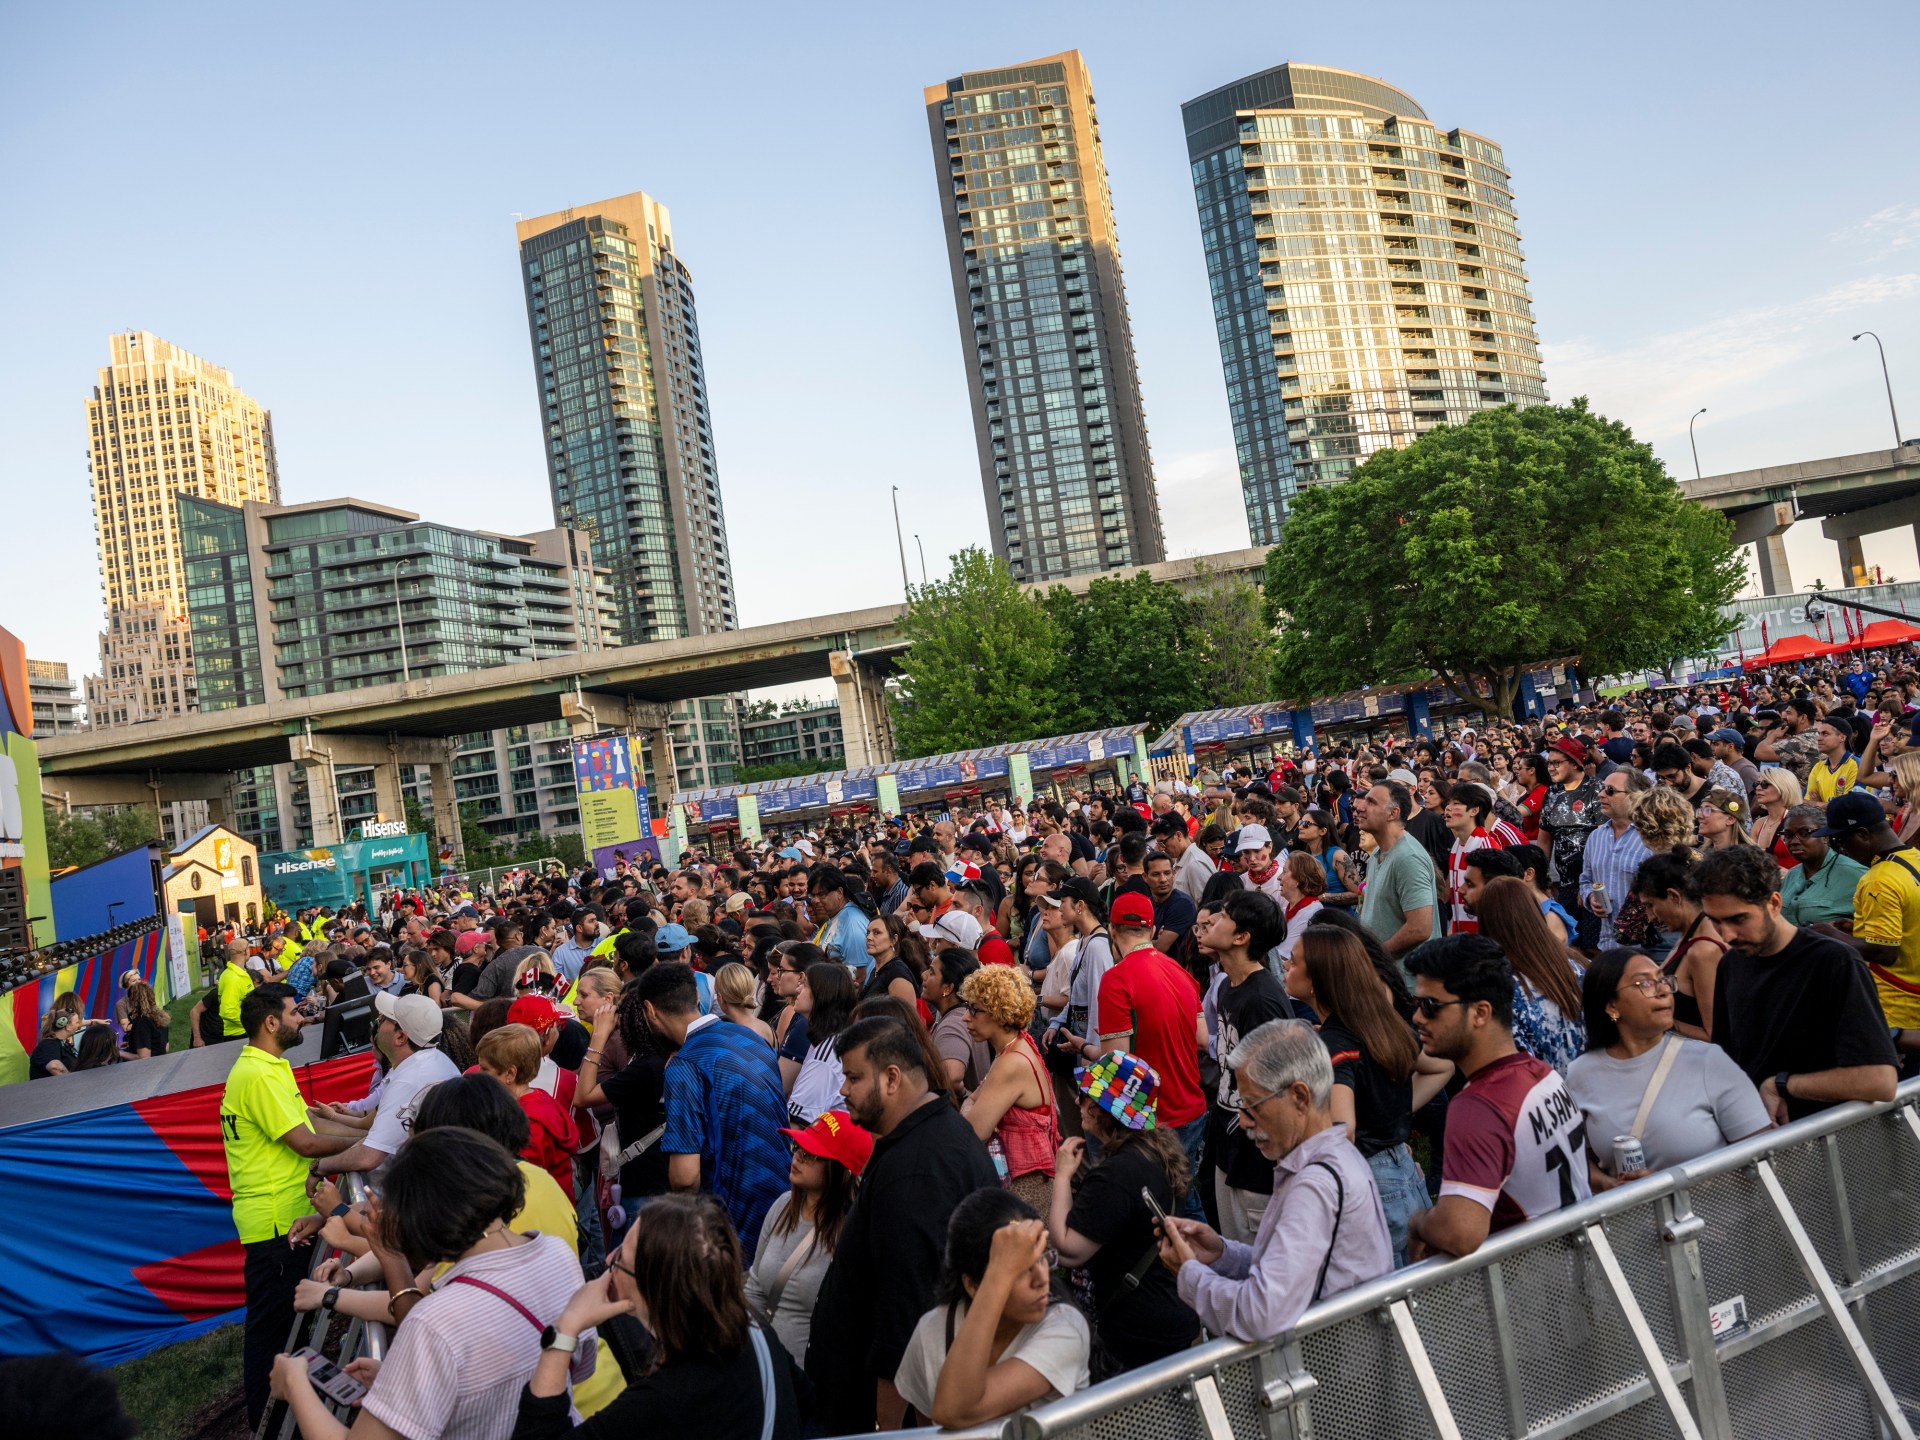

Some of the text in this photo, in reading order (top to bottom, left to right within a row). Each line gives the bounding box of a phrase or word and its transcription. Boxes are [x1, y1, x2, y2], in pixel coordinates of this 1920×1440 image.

[361, 817, 406, 838] Hisense
[274, 857, 336, 875] Hisense
[1528, 1083, 1578, 1146] M.SAM
